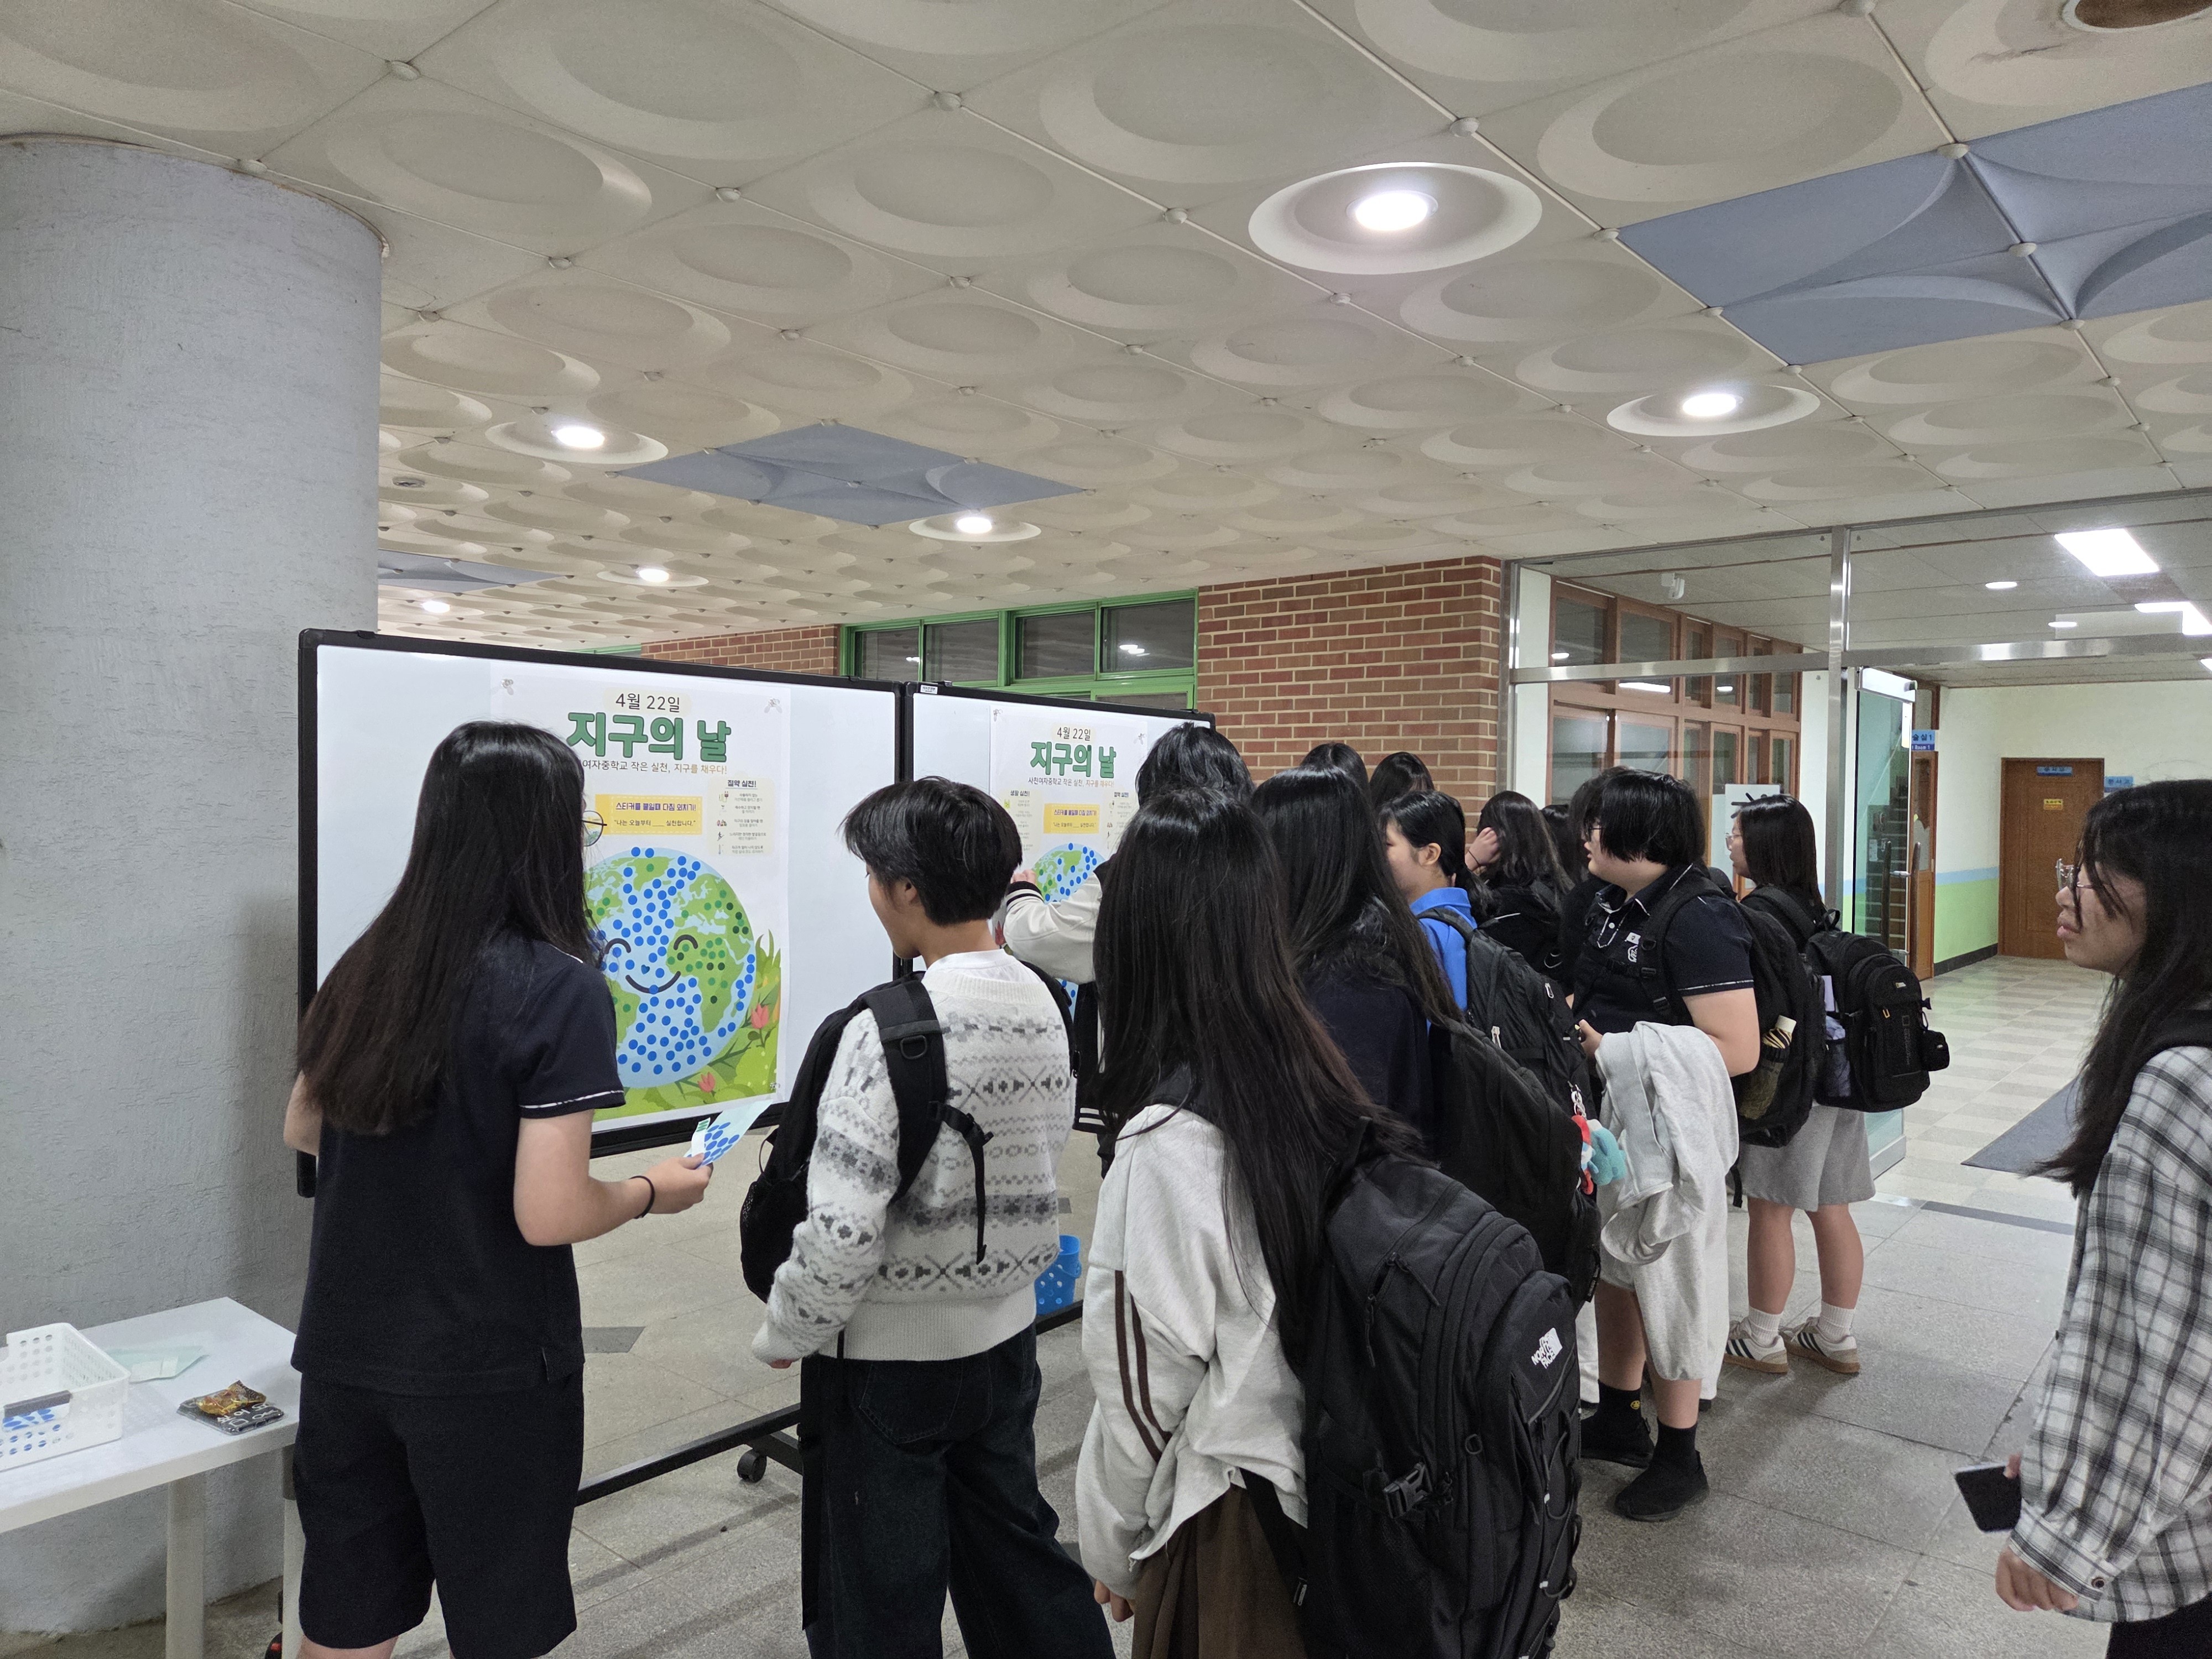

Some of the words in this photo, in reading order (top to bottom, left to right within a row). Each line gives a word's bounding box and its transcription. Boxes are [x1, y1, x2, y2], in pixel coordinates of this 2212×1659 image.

[615, 693, 640, 709] 4월
[646, 696, 680, 712] 22일
[566, 712, 684, 760] 지구의
[697, 720, 732, 763] 날
[1057, 727, 1070, 740] 4월
[1073, 728, 1091, 742] 22일
[582, 760, 628, 770] 여자중학교
[630, 761, 648, 771] 작은
[651, 762, 670, 774] 실천,
[674, 763, 698, 774] 지구를
[701, 764, 727, 775] 채우다!
[1030, 741, 1092, 778] 지구의
[1098, 746, 1117, 779] 날
[1028, 776, 1062, 786] 사천여자중학교
[1086, 779, 1099, 788] 지구를
[615, 802, 641, 811] 스티커를
[662, 803, 675, 811] 다짐
[676, 804, 696, 812] 외치기!
